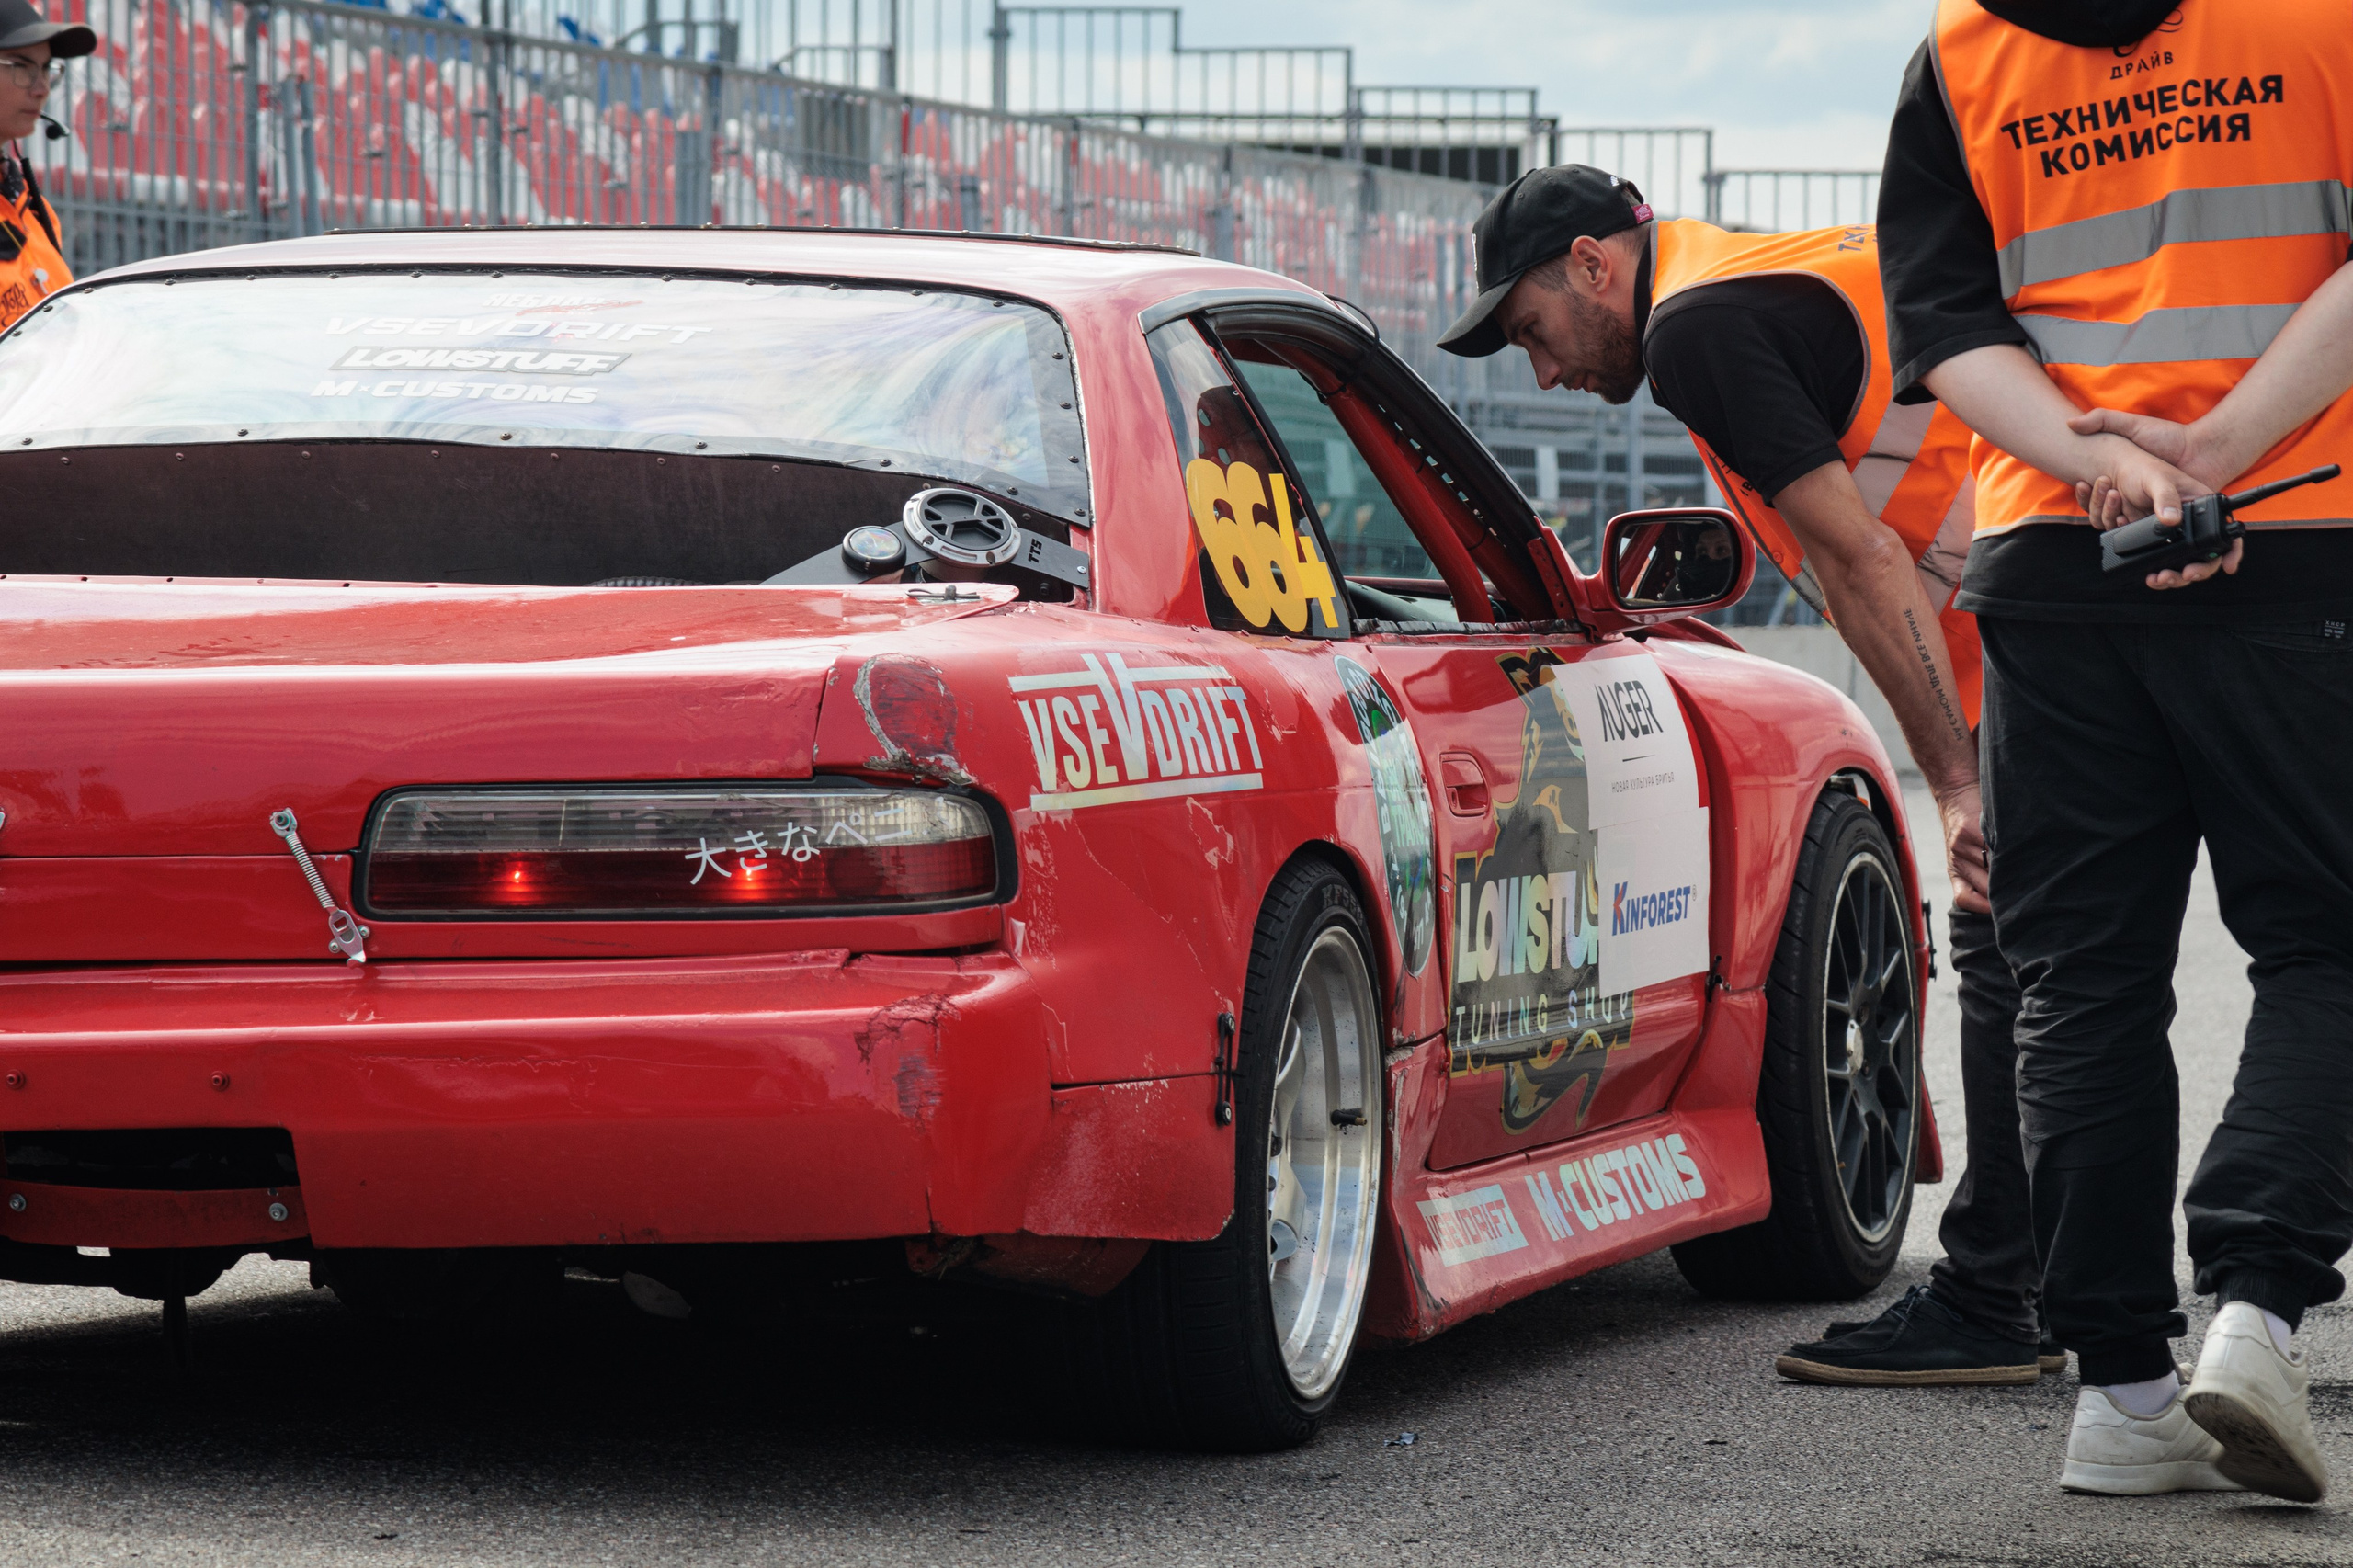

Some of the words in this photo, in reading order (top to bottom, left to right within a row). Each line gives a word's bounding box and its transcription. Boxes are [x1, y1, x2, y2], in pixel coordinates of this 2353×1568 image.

[2109, 51, 2174, 80] ДРАЙВ
[2000, 74, 2284, 150] ТЕХНИЧЕСКАЯ
[2040, 112, 2251, 178] КОМИССИЯ
[324, 317, 713, 345] VSEVDRIFT
[341, 348, 622, 373] LOWSTUFF
[1186, 458, 1339, 632] 664
[1017, 652, 1264, 791] VSEVDRIFT
[1611, 779, 1630, 793] НОВАЯ
[1630, 776, 1655, 790] КУЛЬТУРА
[1655, 771, 1675, 786] БРИТЬЯ
[1457, 870, 1599, 983] LOWSTU
[1455, 993, 1549, 1047] TUNING
